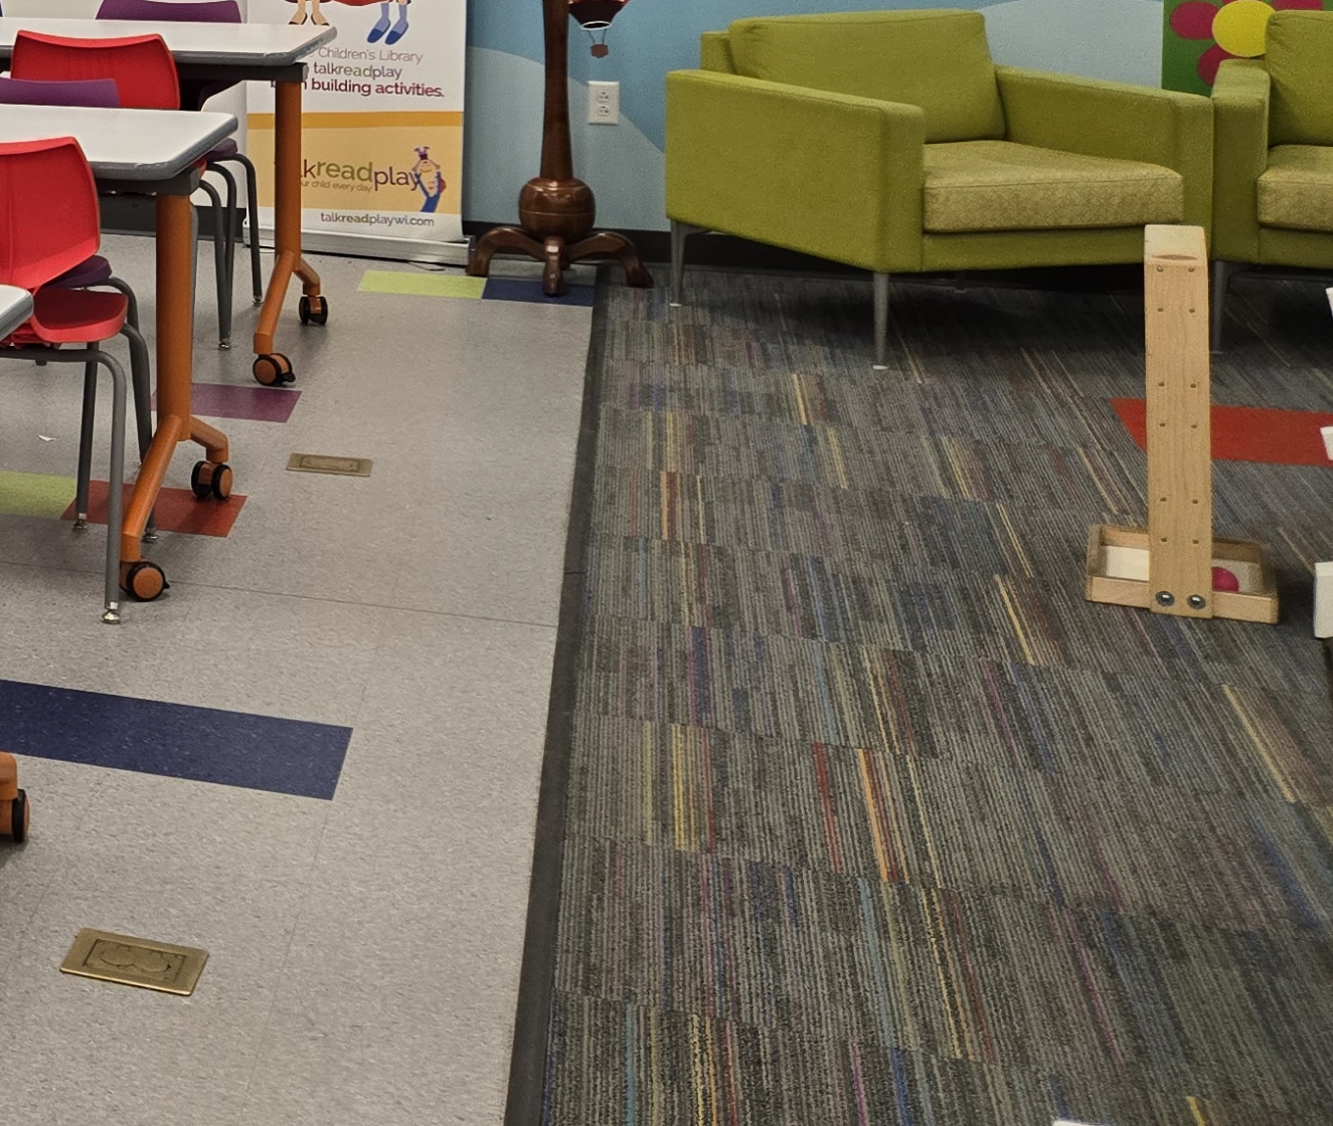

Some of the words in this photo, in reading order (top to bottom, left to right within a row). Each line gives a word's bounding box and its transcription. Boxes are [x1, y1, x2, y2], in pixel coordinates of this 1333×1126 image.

[318, 46, 376, 61] Children's
[379, 49, 423, 65] Library
[313, 62, 403, 80] talkreadplay
[311, 78, 372, 96] building
[375, 82, 445, 97] activities.
